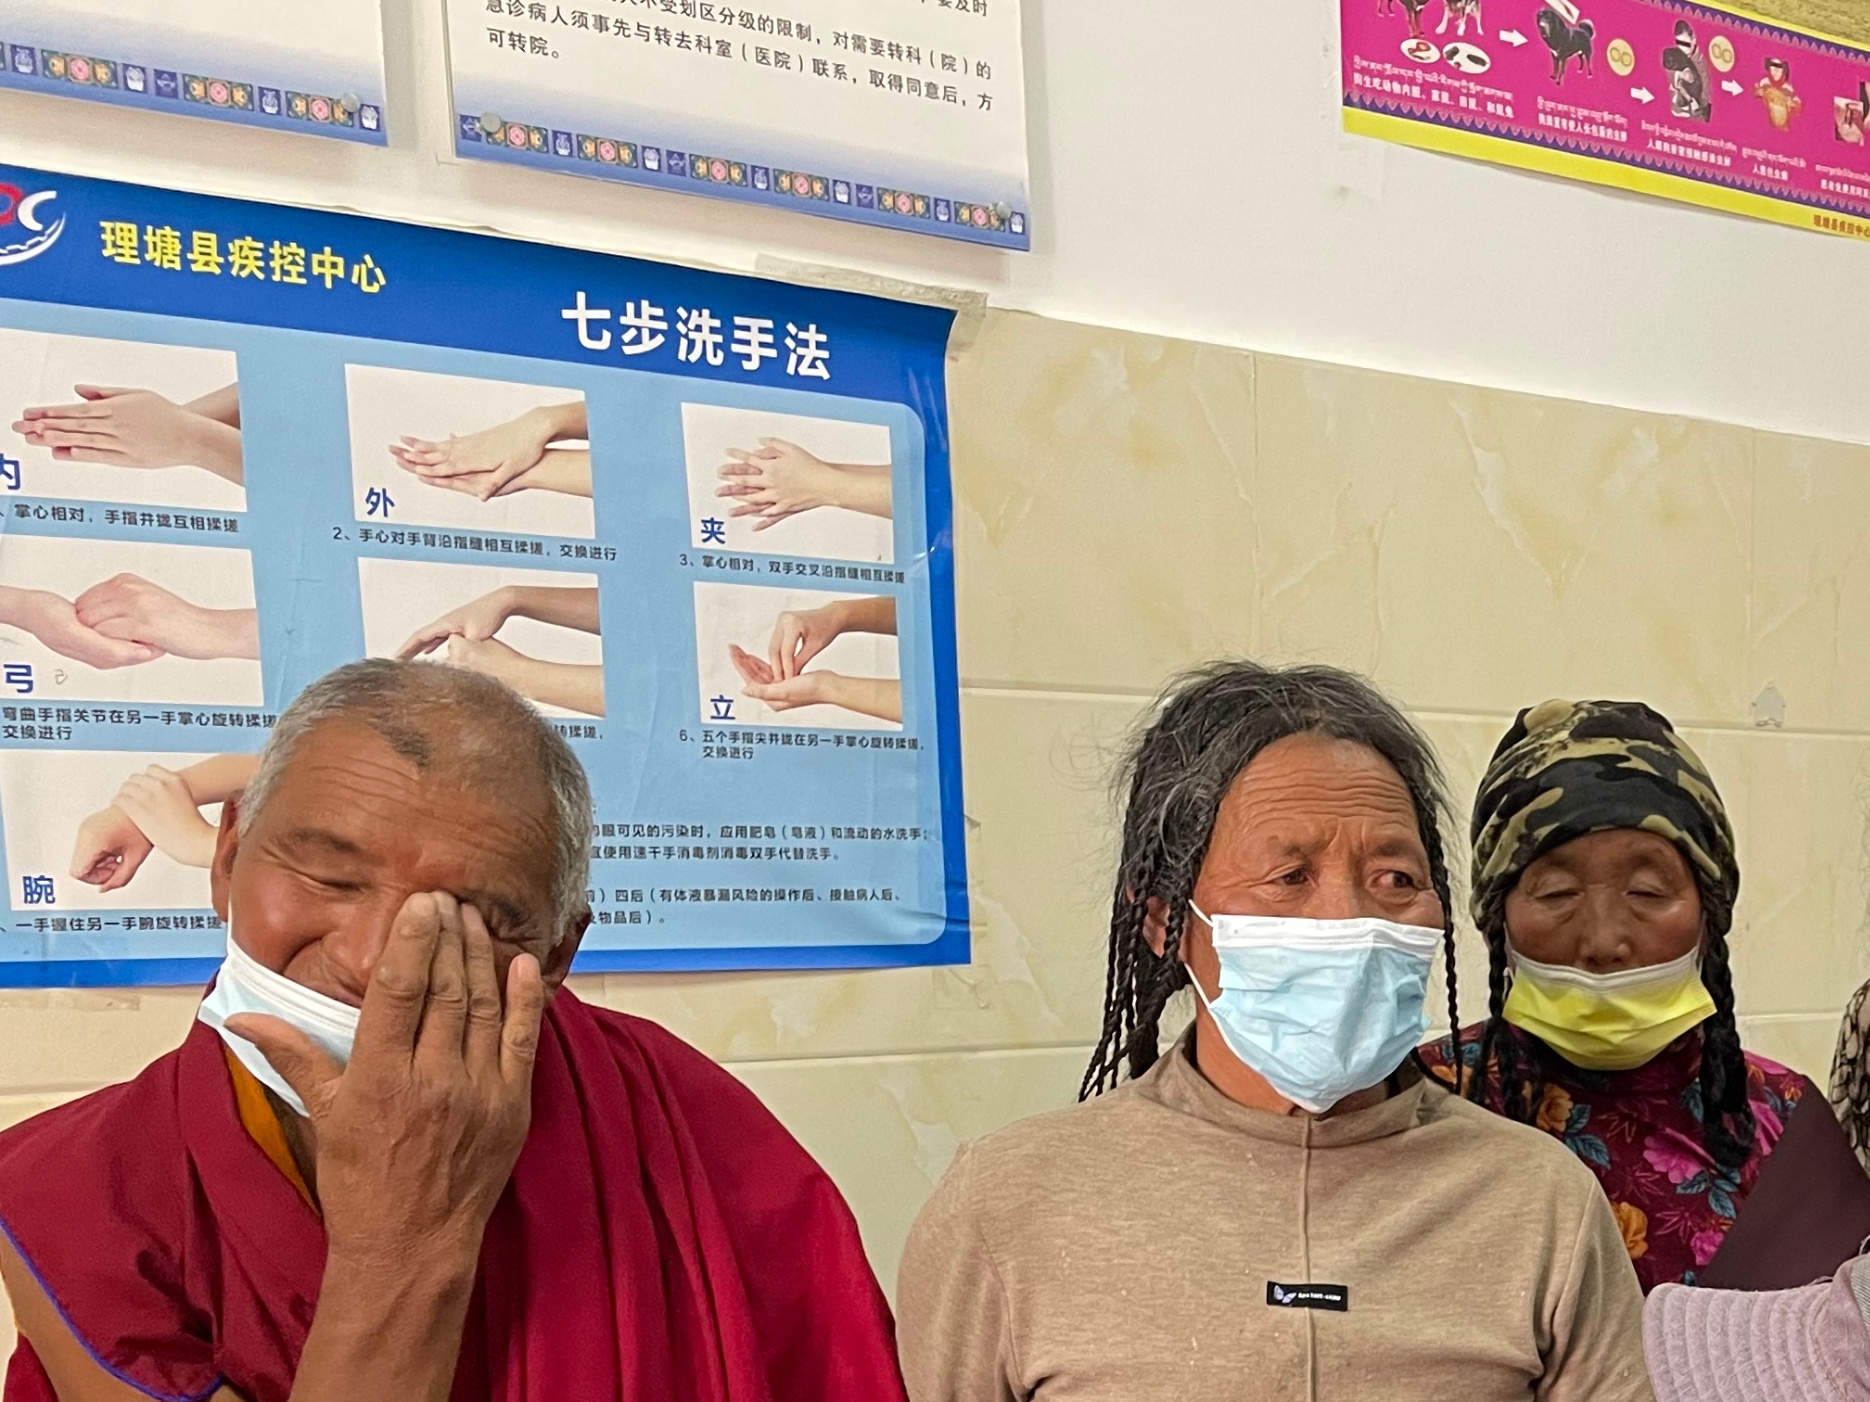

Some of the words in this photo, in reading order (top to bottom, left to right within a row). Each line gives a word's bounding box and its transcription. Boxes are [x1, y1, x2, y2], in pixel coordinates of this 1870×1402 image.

[487, 27, 560, 59] 可转院。
[100, 219, 387, 294] 理塘县疾控中心
[561, 290, 831, 381] 七步洗手法
[365, 487, 395, 518] 外
[701, 517, 726, 544] 夹
[3, 663, 34, 693] 弓
[710, 694, 736, 720] 立
[3, 724, 72, 741] 交换进行
[702, 745, 754, 760] 交换进行
[22, 875, 56, 904] 腕
